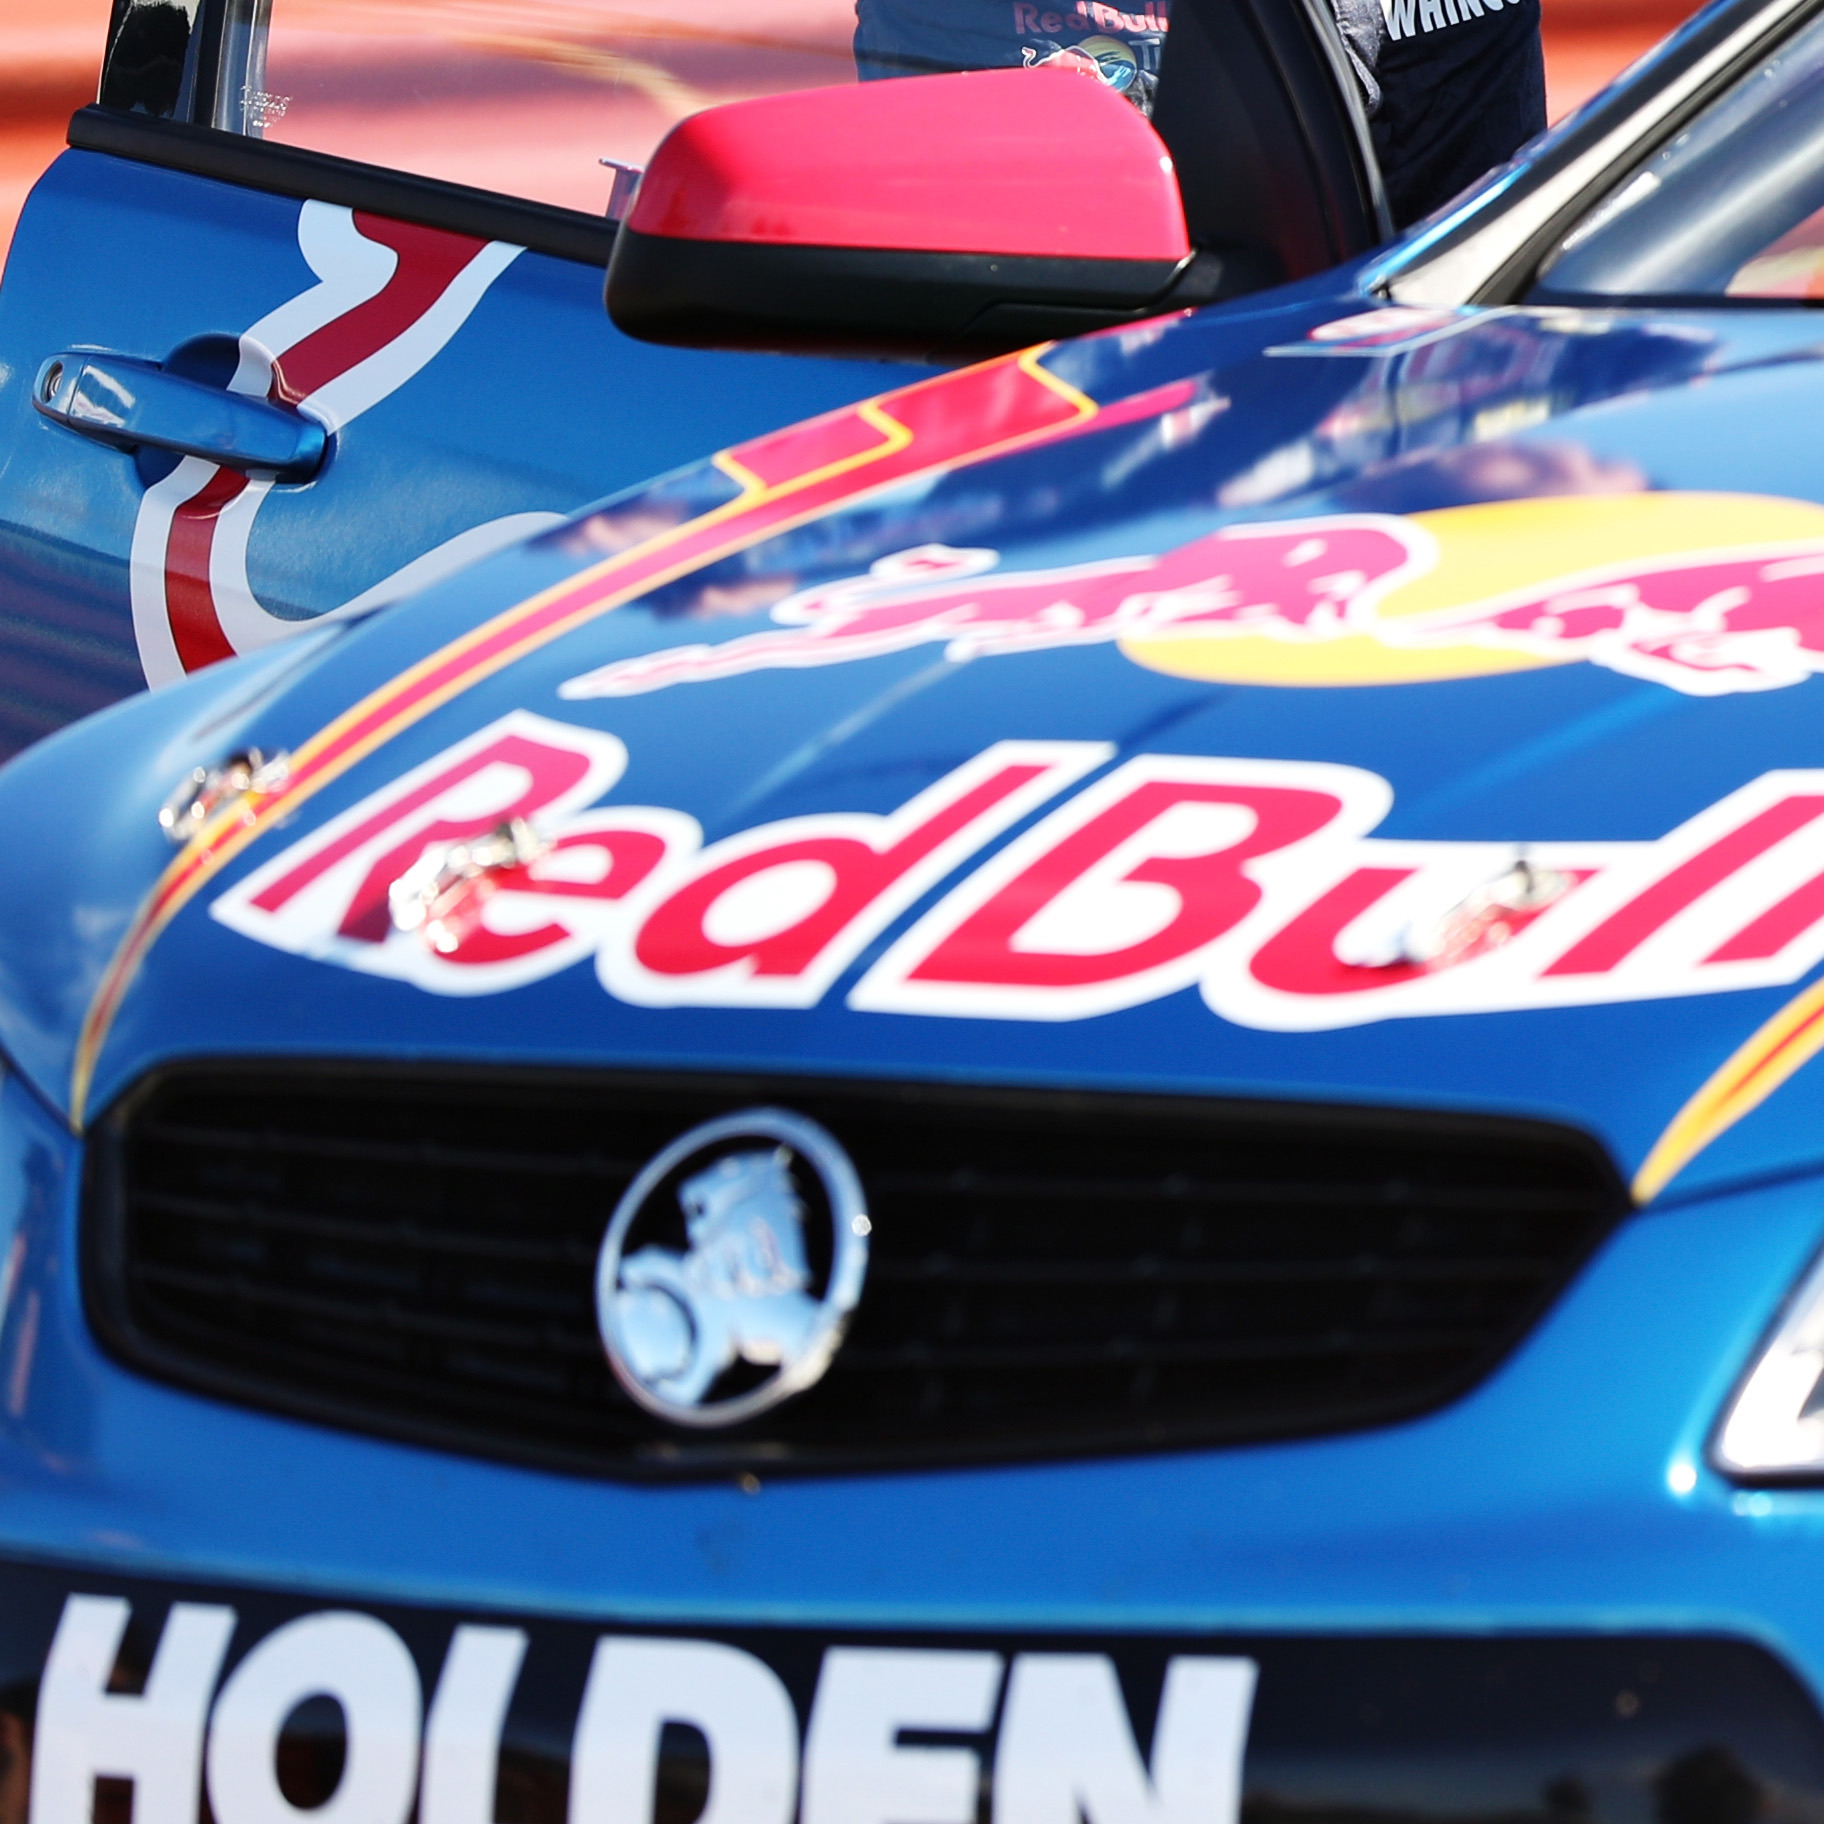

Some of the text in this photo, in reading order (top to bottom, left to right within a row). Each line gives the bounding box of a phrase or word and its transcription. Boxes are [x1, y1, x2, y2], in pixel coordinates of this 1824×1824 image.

[1012, 1, 1169, 34] Red Bull
[210, 709, 1117, 1008] Red
[26, 1592, 1262, 1824] HOLDEN
